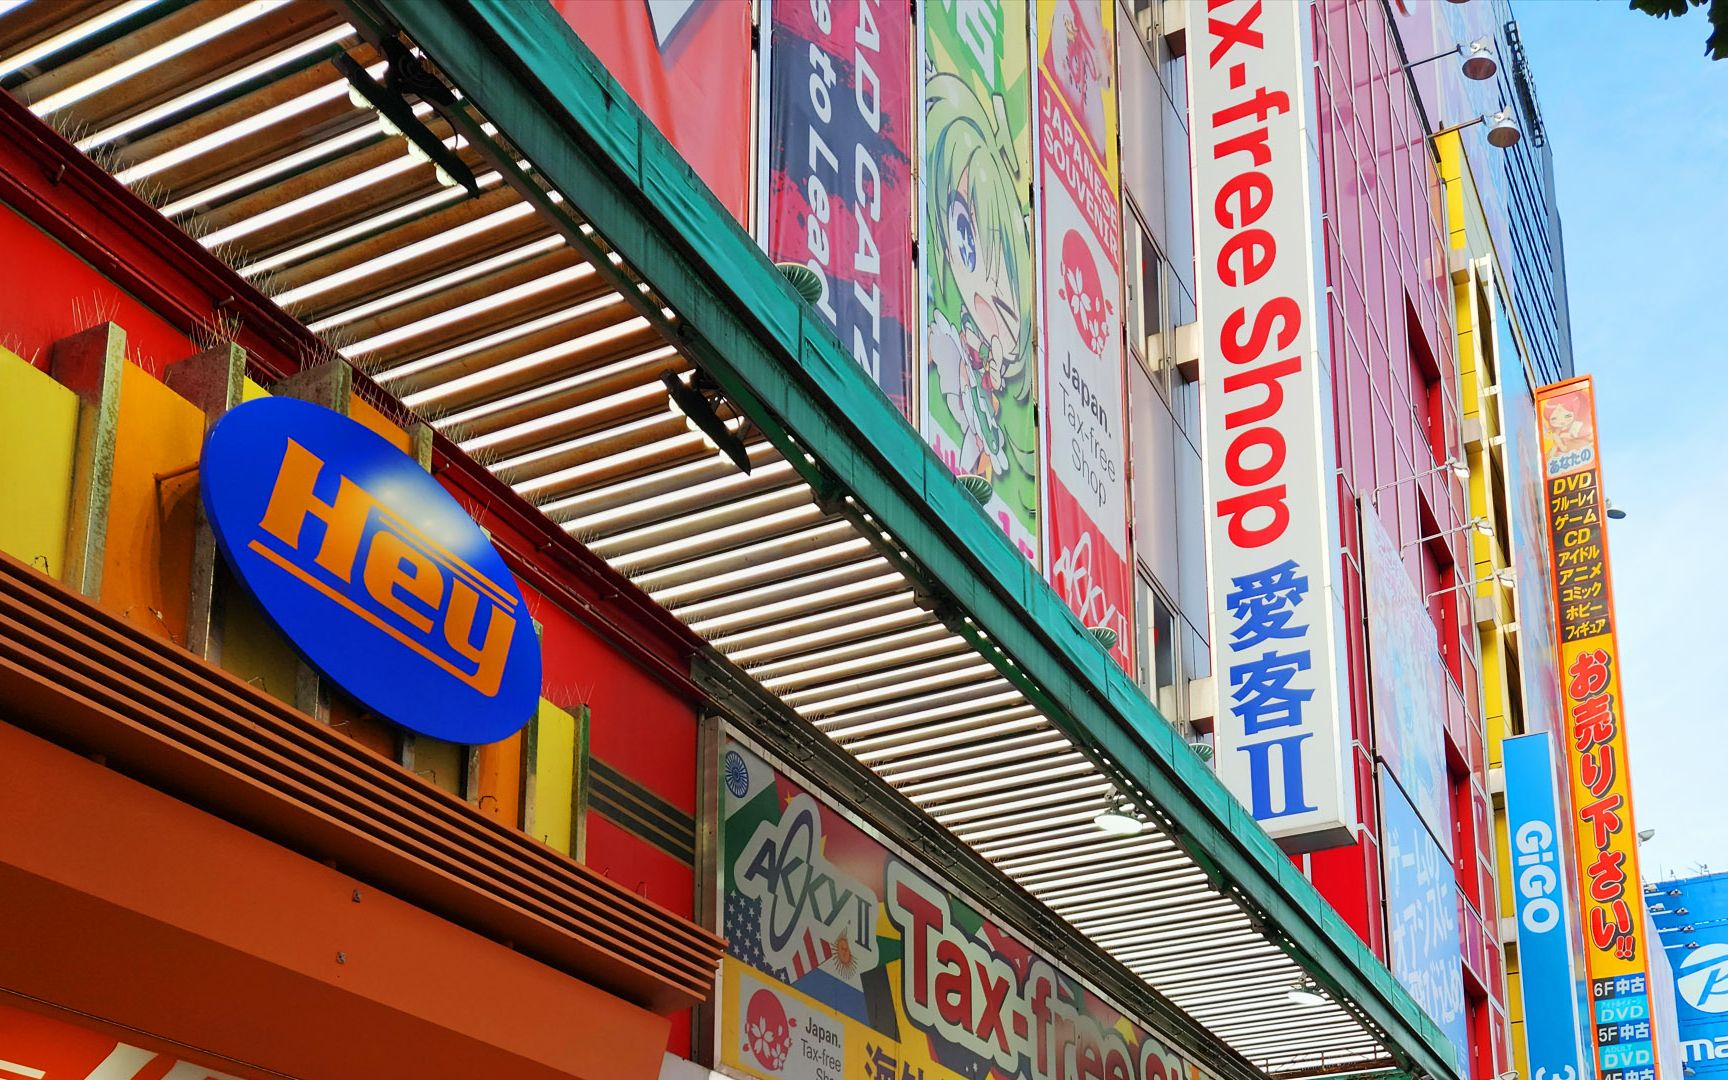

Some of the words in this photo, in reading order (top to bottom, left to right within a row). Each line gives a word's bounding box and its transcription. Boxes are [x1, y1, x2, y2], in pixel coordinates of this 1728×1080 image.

[809, 43, 836, 124] to
[1207, 0, 1291, 287] x-free
[1043, 90, 1118, 231] JAPANESE
[1043, 123, 1118, 266] SOUVENIR
[1062, 353, 1112, 439] Japan.
[1058, 382, 1117, 484] Tax-free
[1217, 296, 1302, 548] Shop
[1071, 439, 1107, 508] Shop
[1548, 448, 1592, 475] あなたの
[1553, 472, 1592, 496] DVD
[1552, 489, 1596, 513] ブルーレイ
[1555, 509, 1597, 531] ゲーム
[1563, 530, 1591, 548] CD
[258, 436, 517, 697] Hey
[1558, 545, 1600, 567] アイドル
[1559, 562, 1602, 586] アニメ
[1562, 582, 1602, 603] コミック
[1565, 603, 1603, 622] ホビー
[1565, 619, 1606, 641] フィギュア
[1515, 819, 1560, 933] GiGO
[1593, 981, 1614, 998] 6F
[1616, 976, 1646, 995] 中古
[1601, 1005, 1644, 1021] DVD
[805, 1017, 841, 1049] Japan.
[1599, 1028, 1617, 1042] 5F
[1620, 1022, 1650, 1040] 中古
[800, 1038, 842, 1073] Tax-free
[1604, 1050, 1650, 1067] DVD
